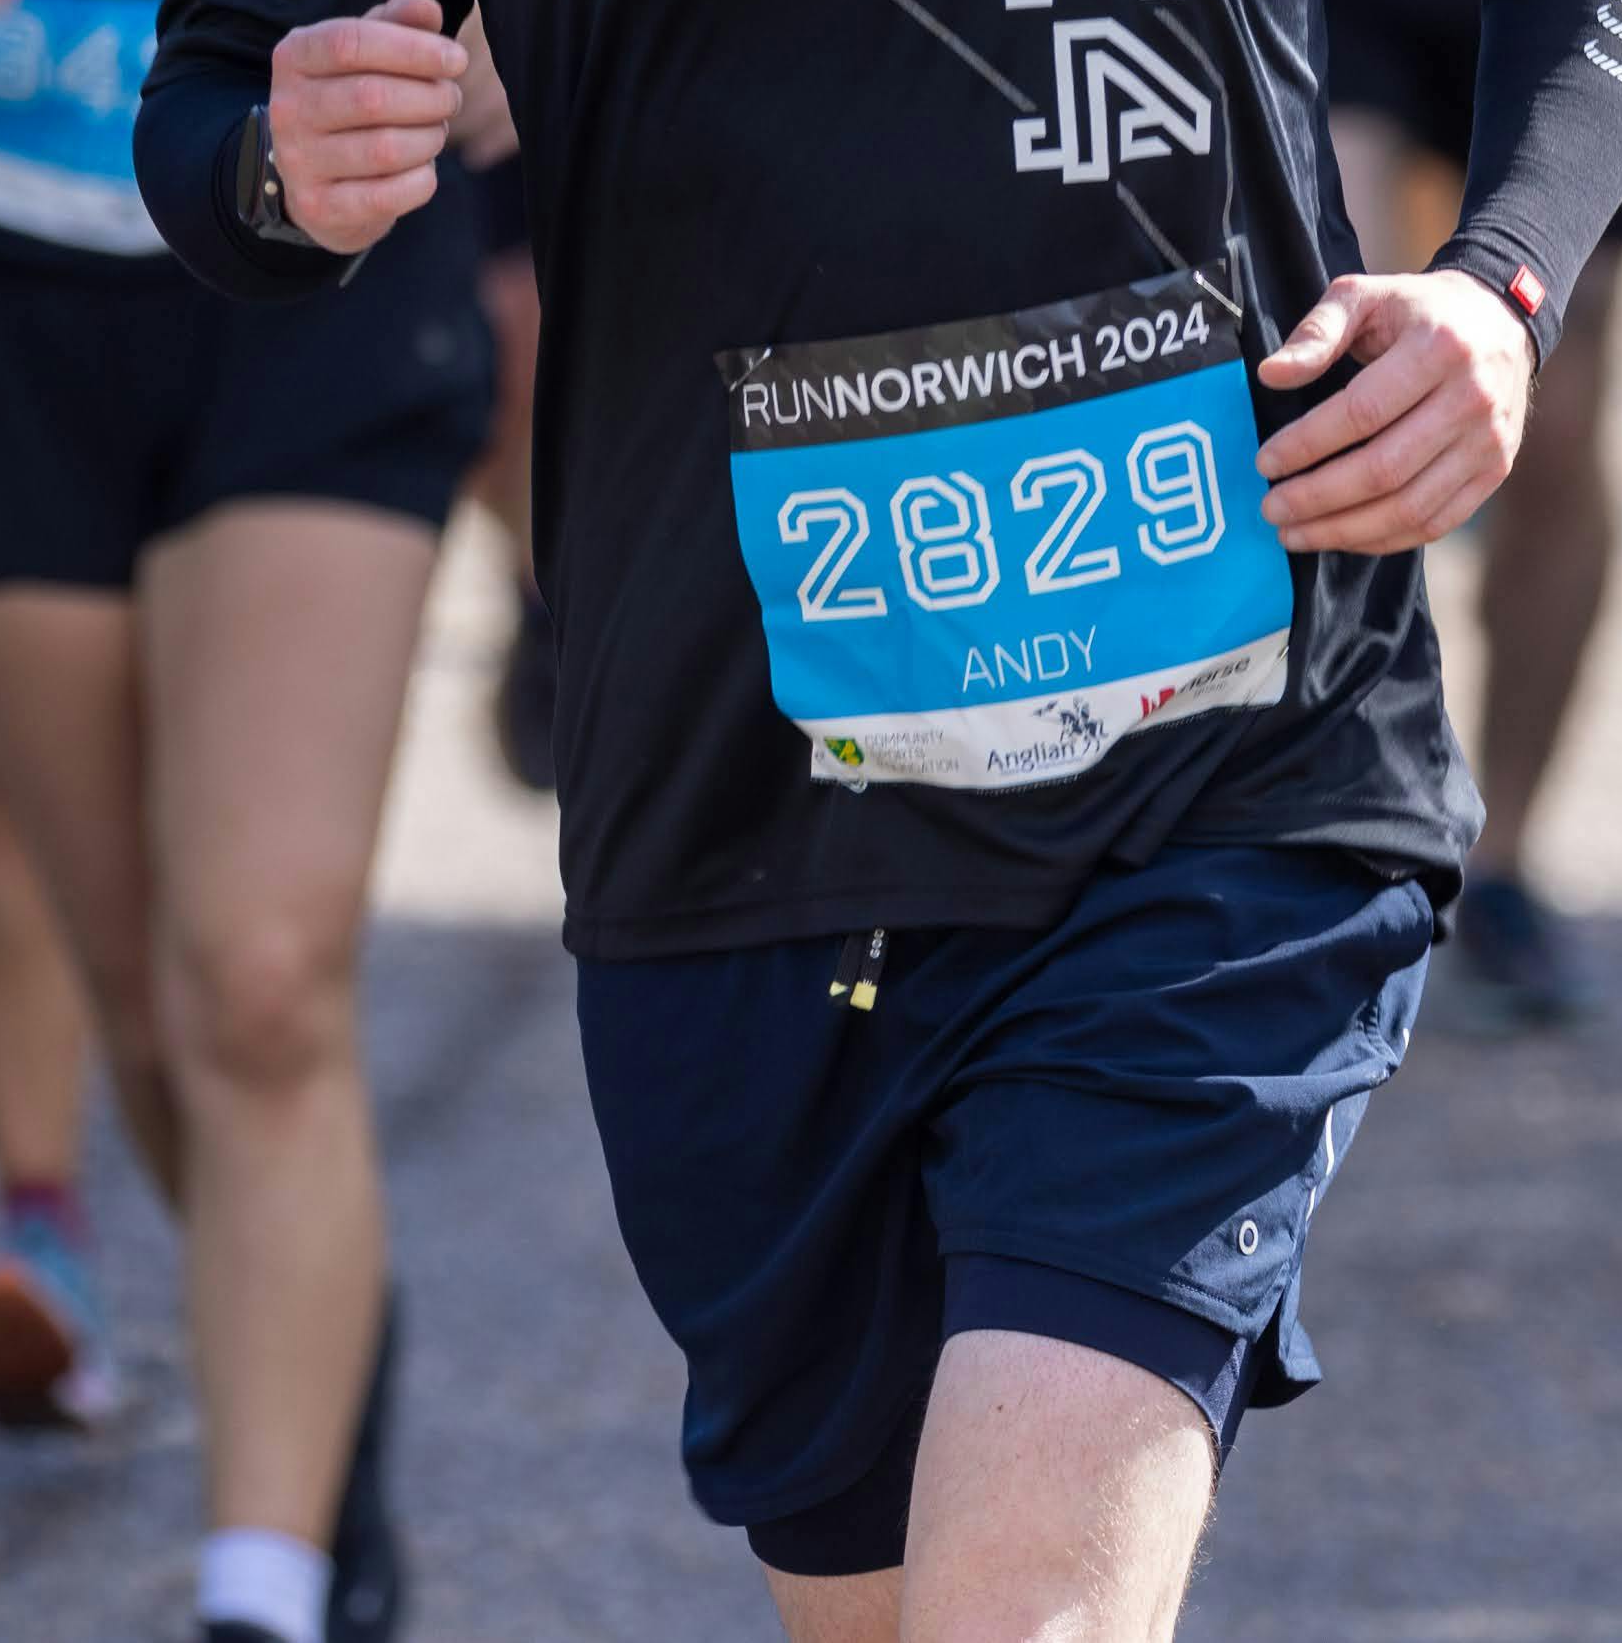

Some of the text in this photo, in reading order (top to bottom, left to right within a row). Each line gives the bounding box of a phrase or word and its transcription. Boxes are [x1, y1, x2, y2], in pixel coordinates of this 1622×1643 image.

[741, 300, 1211, 429] RUNNORWICH 2024
[777, 419, 1227, 624] 2829
[961, 625, 1099, 693] ANDY
[985, 741, 1076, 773] Anglian
